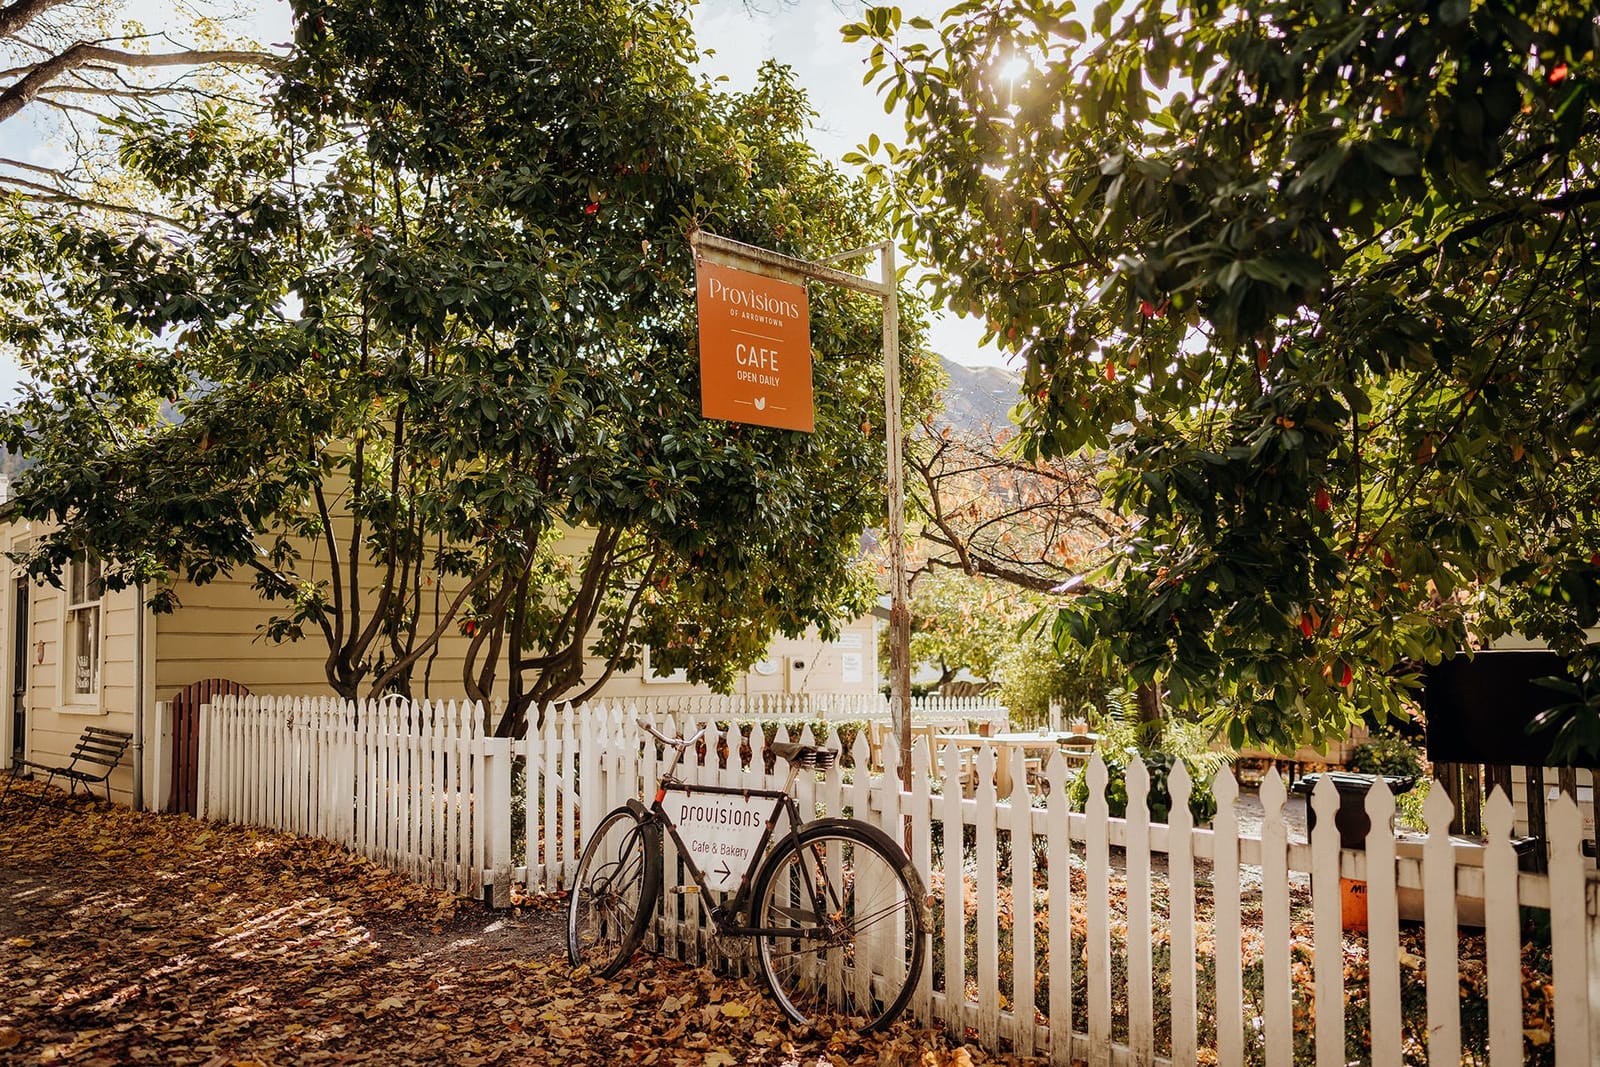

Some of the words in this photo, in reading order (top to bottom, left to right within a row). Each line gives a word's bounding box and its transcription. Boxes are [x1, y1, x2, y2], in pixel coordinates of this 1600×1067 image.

[709, 278, 799, 319] Provisions
[730, 308, 739, 317] OF
[741, 311, 783, 327] ARROWTOWN
[736, 343, 779, 371] CAFE
[737, 370, 757, 383] OPEN
[759, 374, 779, 387] DAILY
[680, 801, 760, 828] provisions
[692, 840, 710, 853] Cafe
[711, 843, 718, 854] &
[720, 843, 749, 860] Bakery
[1350, 885, 1367, 894] MI
